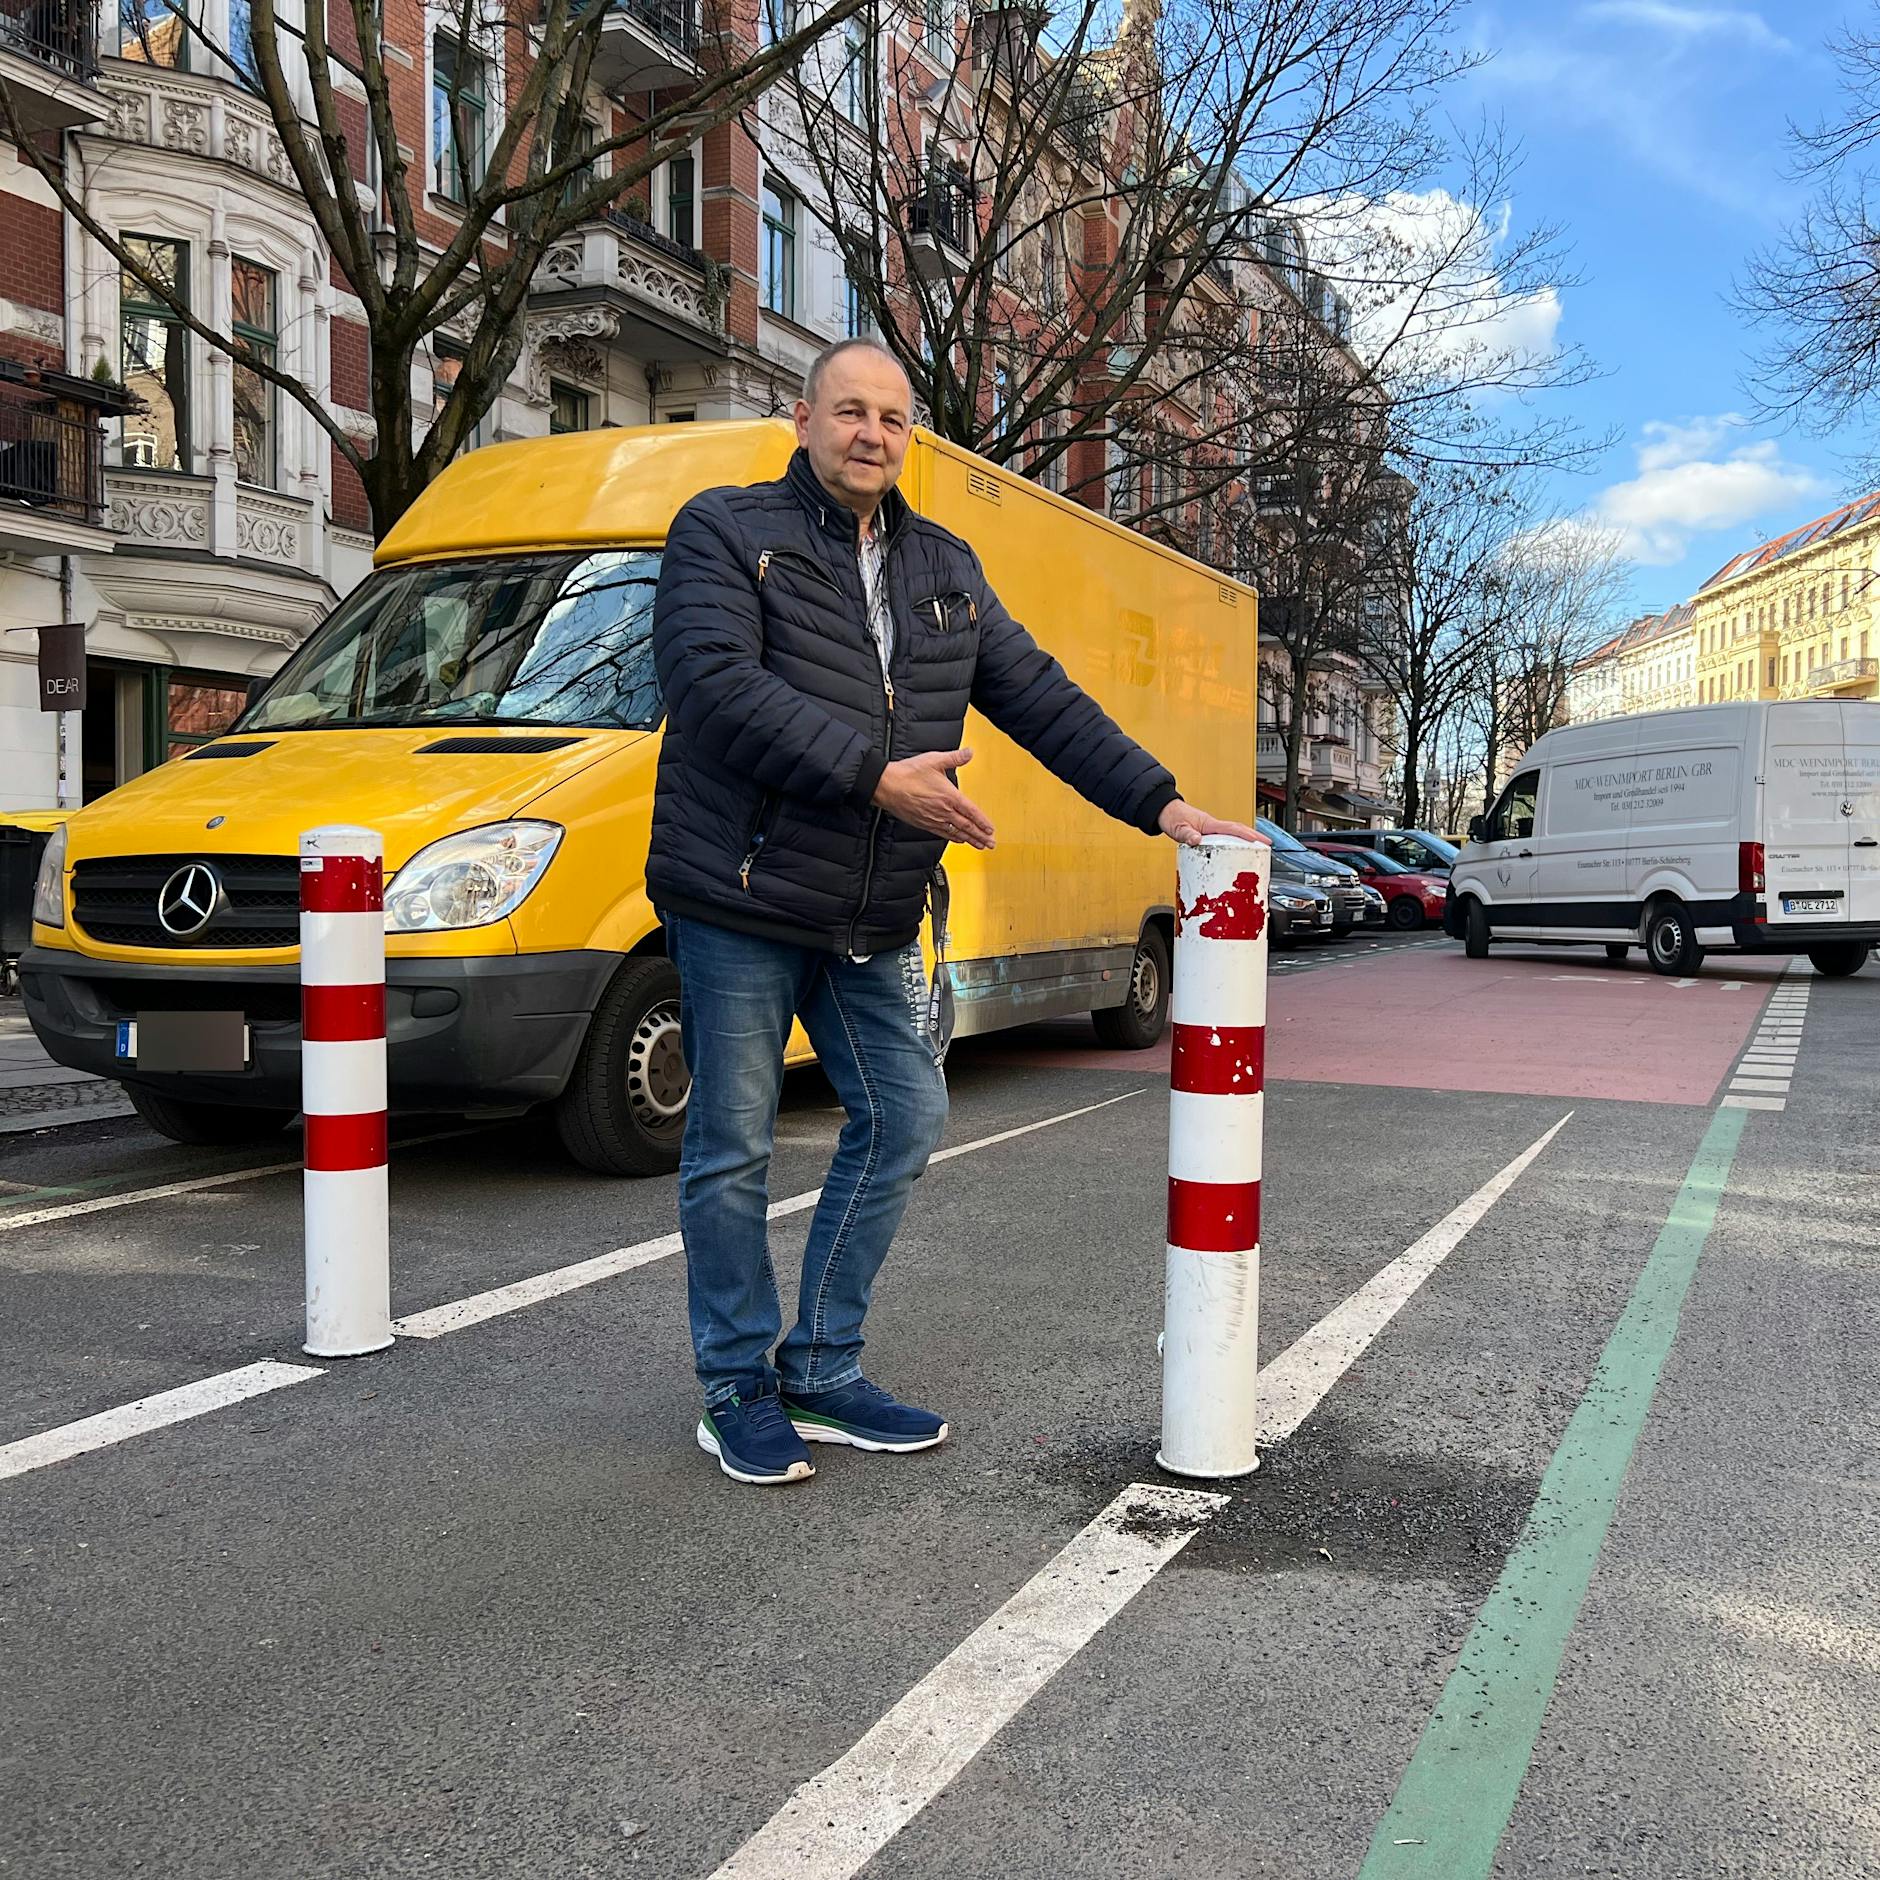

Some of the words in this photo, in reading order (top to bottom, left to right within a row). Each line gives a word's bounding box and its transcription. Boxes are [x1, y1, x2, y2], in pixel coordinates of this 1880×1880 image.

[47, 678, 79, 694] DEAR
[1774, 758, 1857, 768] MDC-WEINIMPORT
[1575, 770, 1654, 790] MDC-WEINIMPORT
[1656, 765, 1688, 780] BERLIN
[1691, 762, 1712, 777] GBR
[1670, 783, 1685, 793] 1994
[1790, 901, 1796, 911] B
[1802, 900, 1813, 910] QE
[1815, 900, 1836, 910] 2712
[930, 1001, 940, 1019] CAMP
